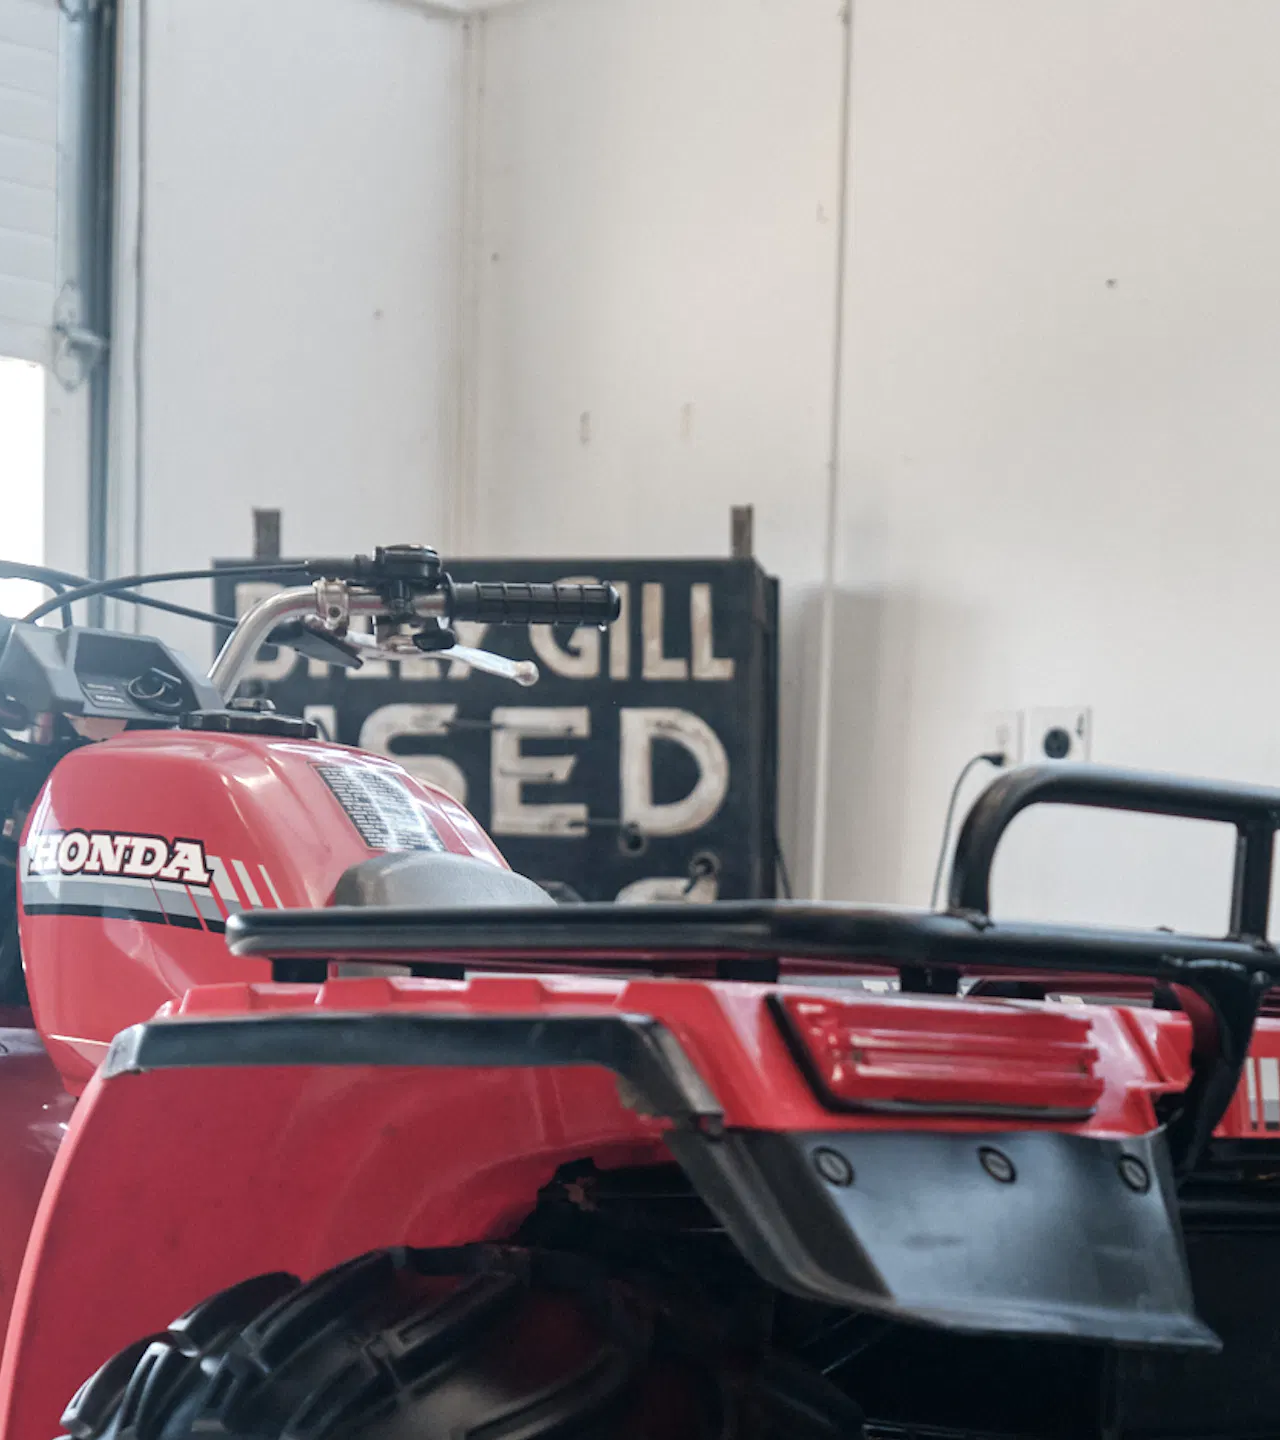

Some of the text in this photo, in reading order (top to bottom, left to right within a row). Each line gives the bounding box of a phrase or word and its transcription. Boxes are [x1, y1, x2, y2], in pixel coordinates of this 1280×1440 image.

[529, 576, 735, 680] GILL
[303, 703, 730, 837] SED
[28, 830, 213, 886] HONDA
